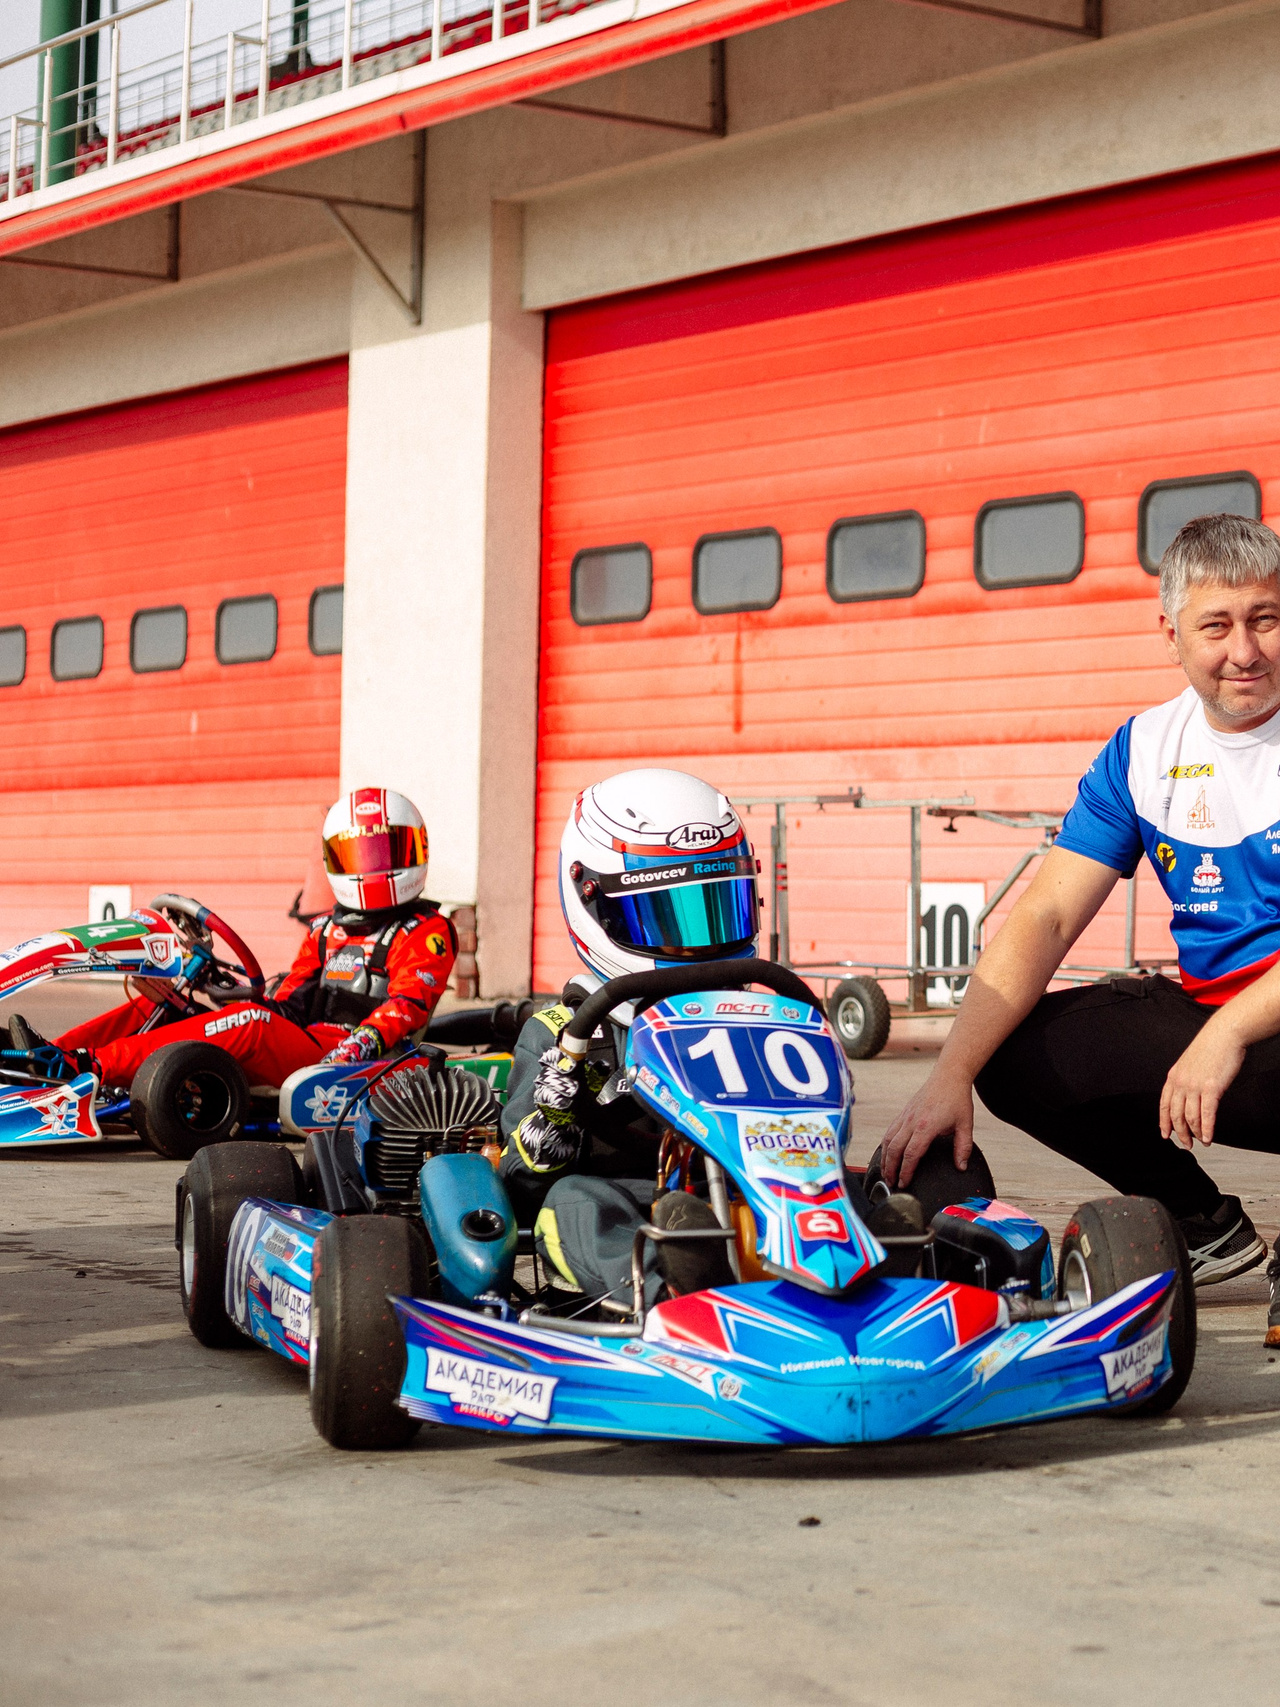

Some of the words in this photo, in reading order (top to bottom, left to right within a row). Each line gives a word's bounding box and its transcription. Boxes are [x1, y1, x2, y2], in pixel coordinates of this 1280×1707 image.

[1167, 763, 1214, 780] VEGA
[670, 826, 717, 847] Arai
[620, 867, 687, 885] Gotovcev
[693, 860, 736, 875] Racing
[921, 904, 969, 990] 10
[204, 1008, 271, 1038] SEROVA
[687, 1027, 830, 1097] 10
[744, 1134, 837, 1152] РОССИЯ
[780, 1355, 846, 1375] Нижний
[848, 1353, 926, 1372] Новгород
[434, 1357, 544, 1404] АКАДЕМИЯ
[470, 1390, 496, 1406] РАФ
[459, 1402, 505, 1423] МИКРО
